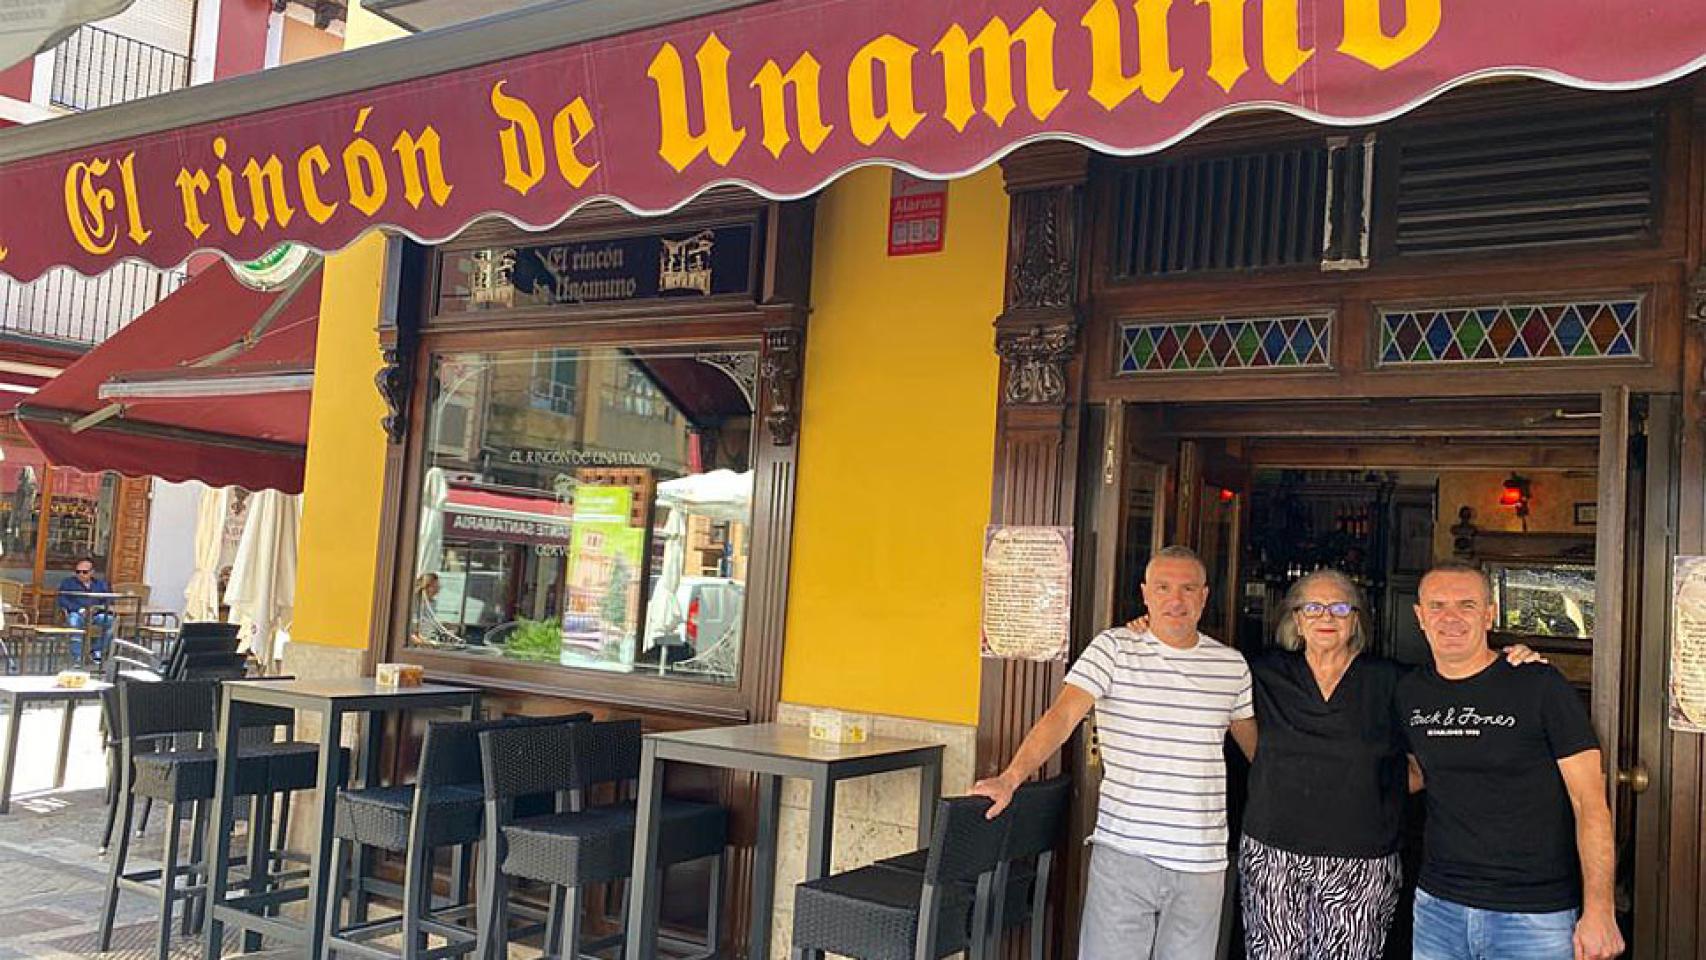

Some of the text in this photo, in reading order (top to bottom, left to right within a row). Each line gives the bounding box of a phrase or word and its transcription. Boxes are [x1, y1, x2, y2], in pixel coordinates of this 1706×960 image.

[64, 0, 1440, 255] El rincón de Unamuno
[1410, 707, 1516, 728] Jack & Jones
